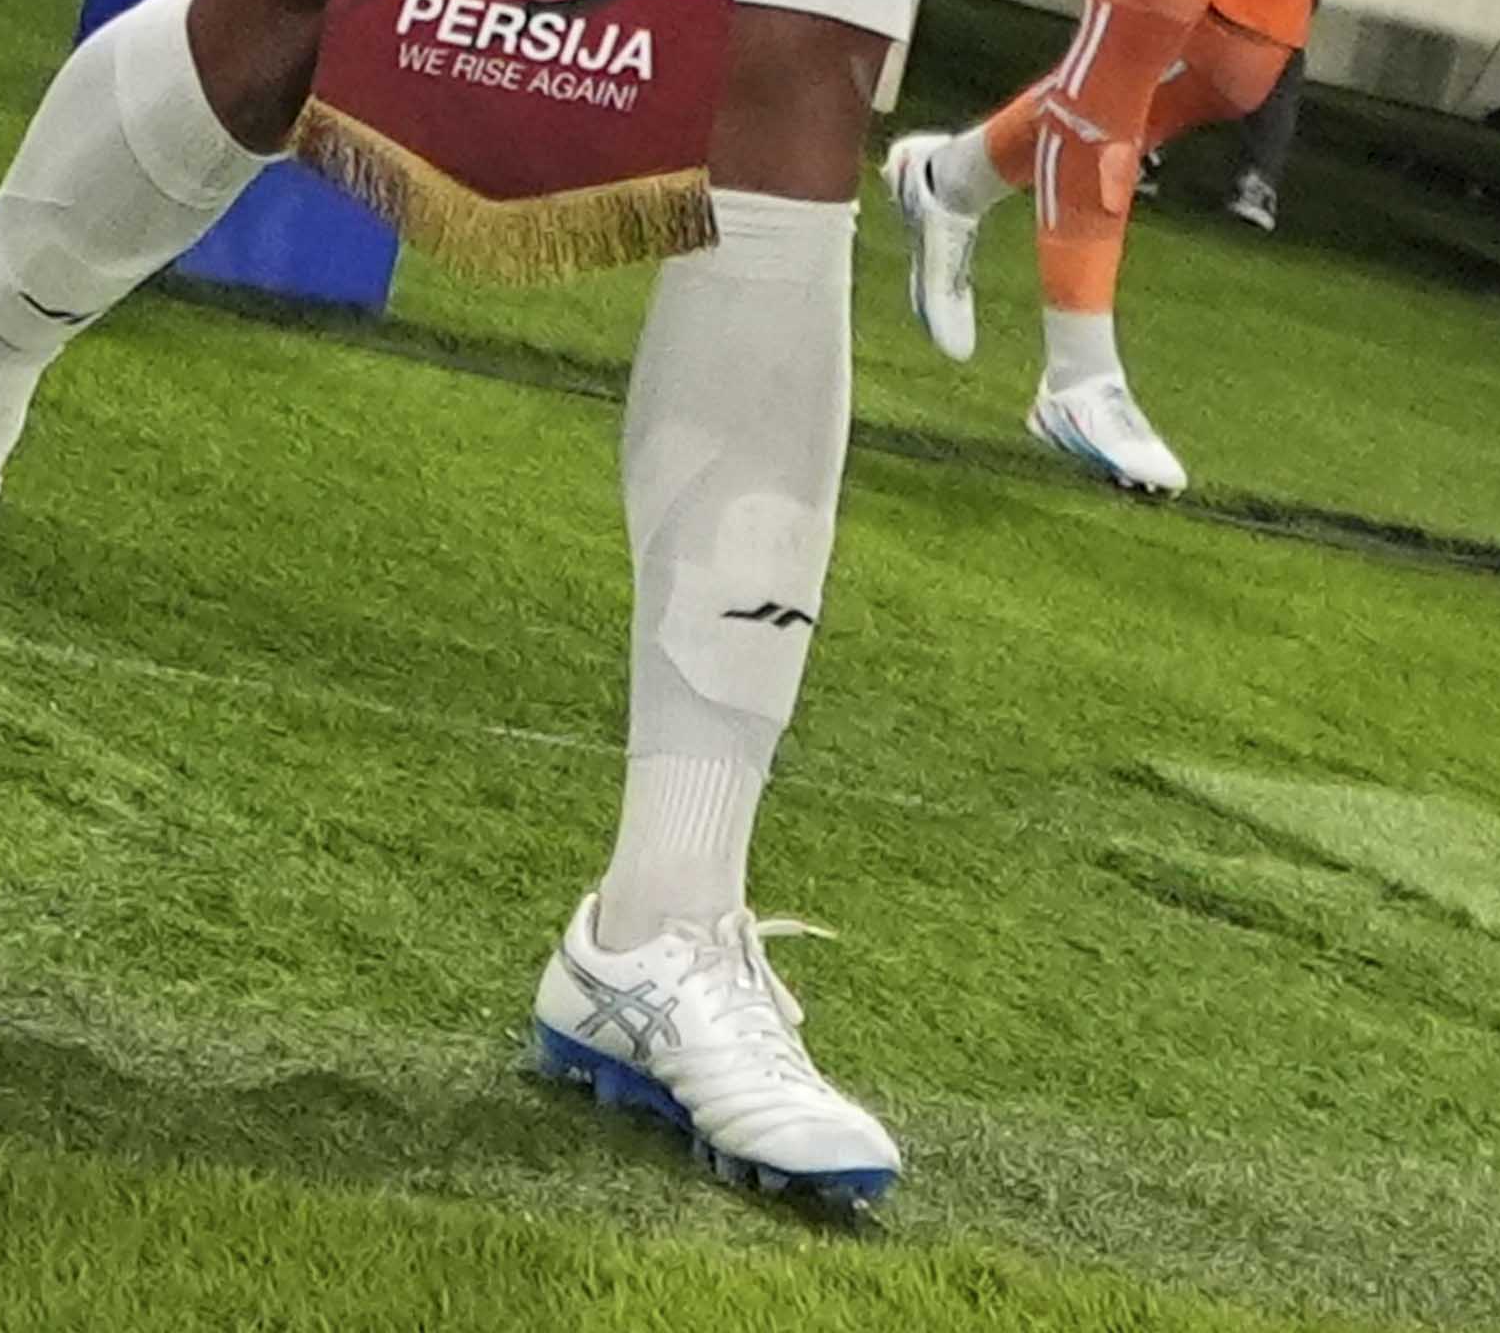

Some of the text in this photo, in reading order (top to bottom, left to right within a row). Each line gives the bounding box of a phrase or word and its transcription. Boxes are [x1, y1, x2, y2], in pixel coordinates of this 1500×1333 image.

[398, 41, 639, 112] WE RISE AGAIN!
